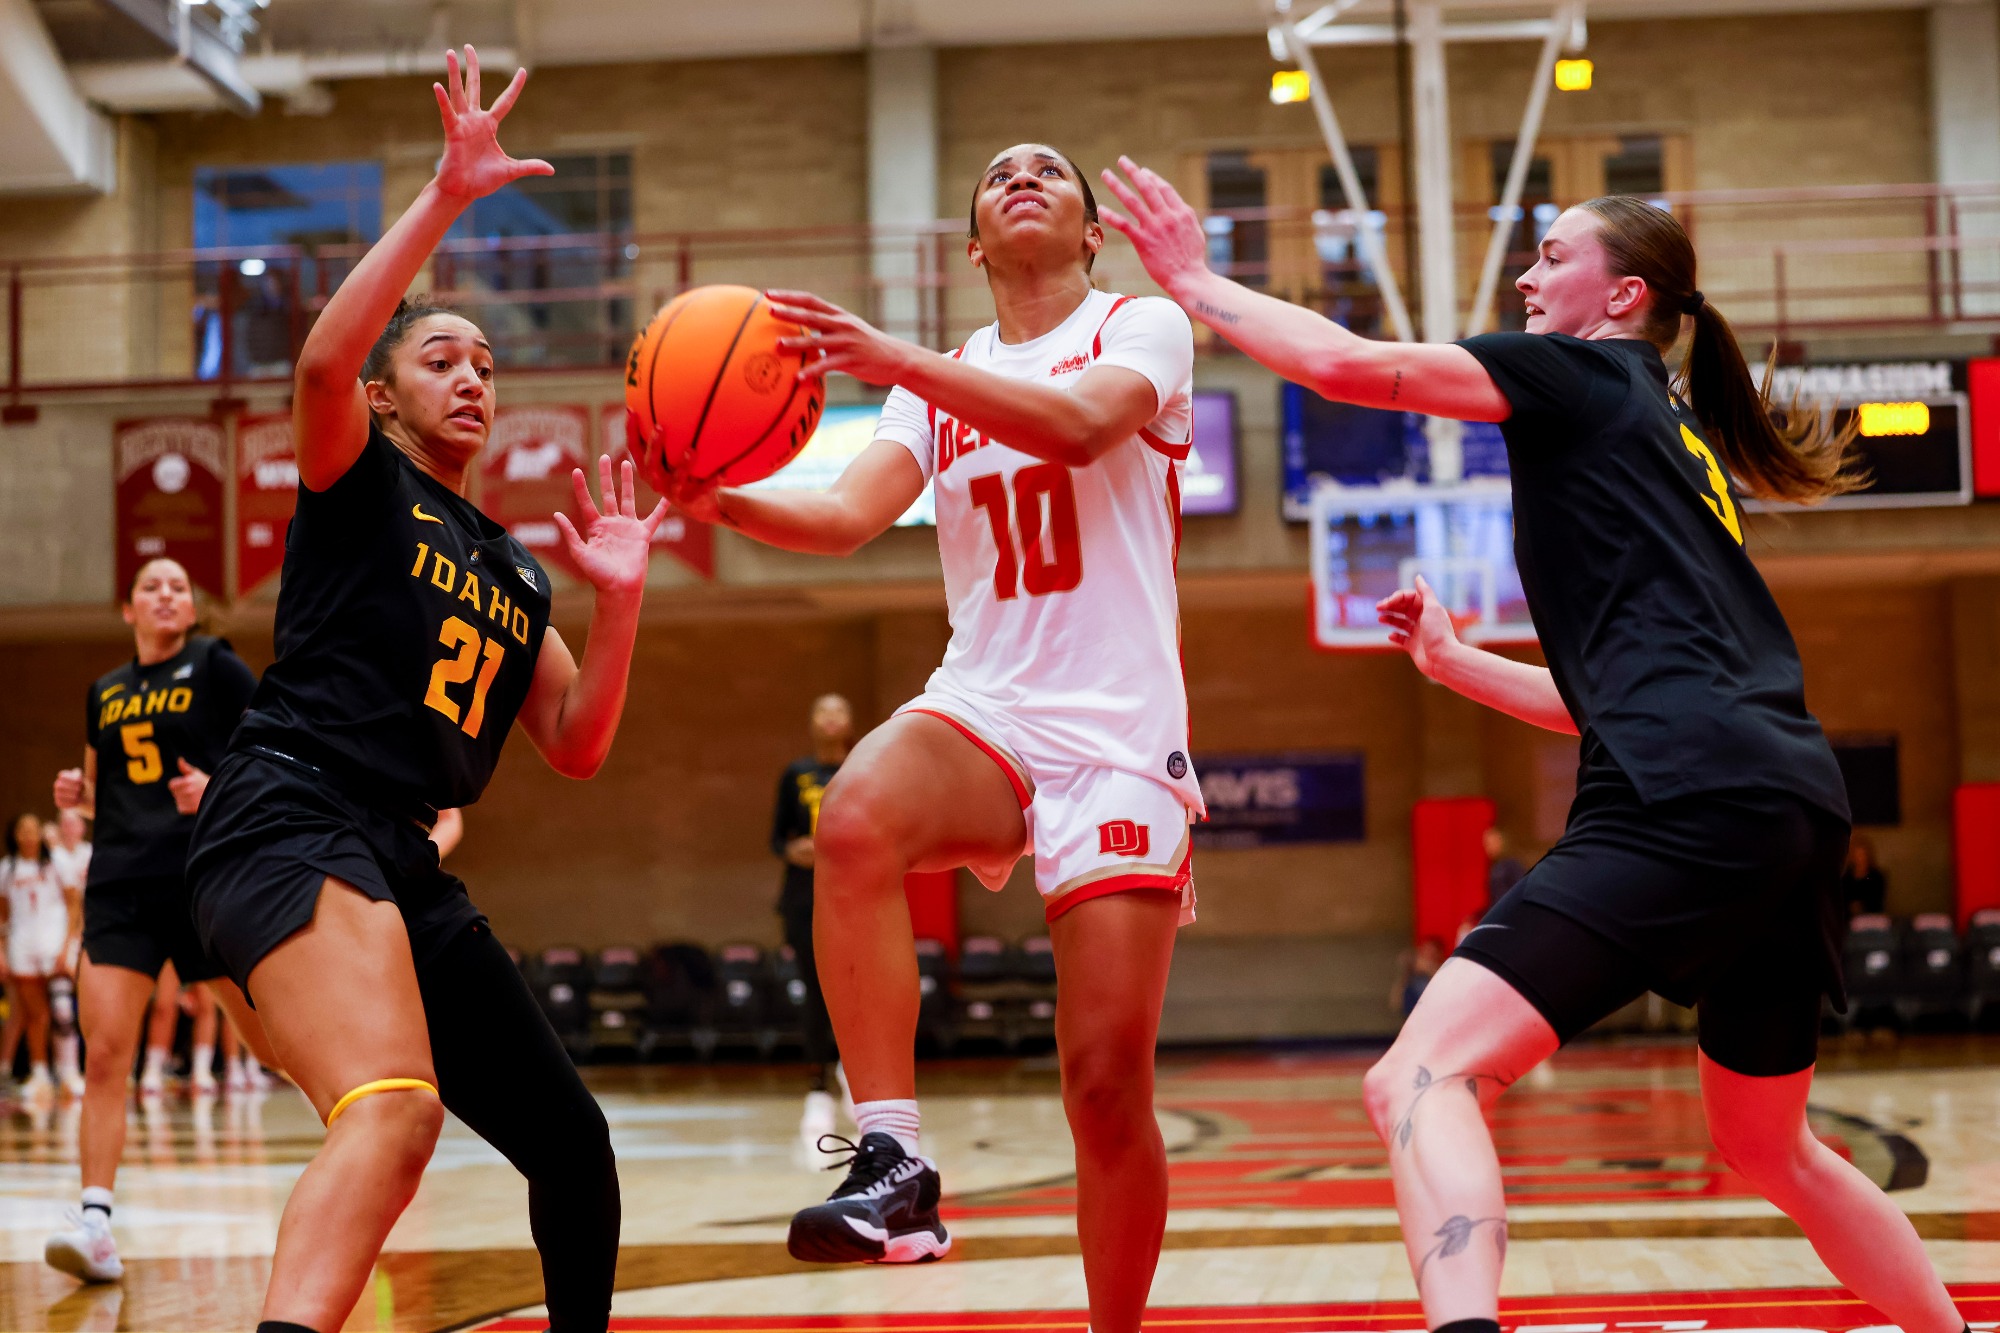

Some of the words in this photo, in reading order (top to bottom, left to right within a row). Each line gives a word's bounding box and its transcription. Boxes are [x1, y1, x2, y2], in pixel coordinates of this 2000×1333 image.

[968, 462, 1083, 602] 10
[1679, 422, 1743, 546] 3
[411, 542, 529, 646] IDAHO
[98, 687, 193, 730] IDAHO
[423, 615, 505, 739] 21
[120, 720, 164, 785] 5
[1096, 818, 1150, 858] DU
